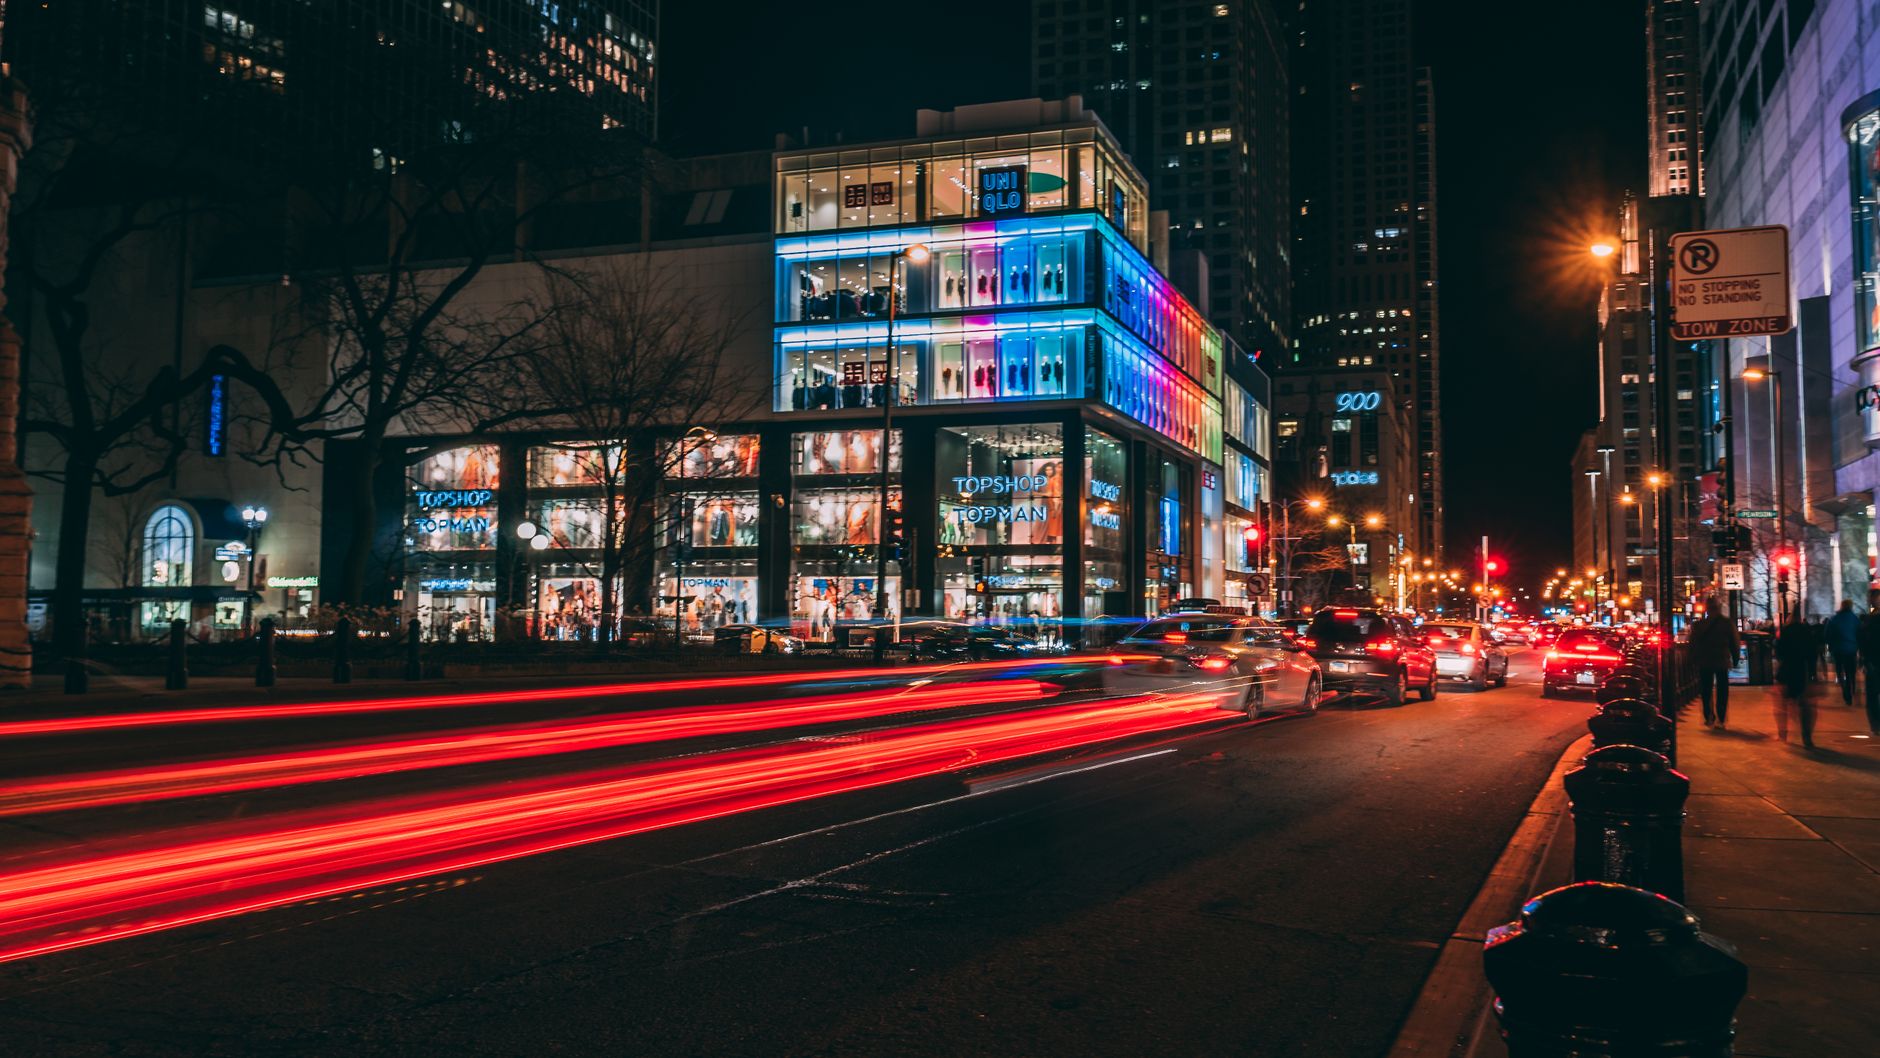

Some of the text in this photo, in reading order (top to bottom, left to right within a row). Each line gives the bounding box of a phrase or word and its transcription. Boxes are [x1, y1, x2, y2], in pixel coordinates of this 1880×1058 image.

[983, 171, 1018, 191] UNI
[983, 191, 1021, 213] QLO
[1679, 279, 1761, 294] NO STOPPING
[1679, 291, 1762, 306] NO STANDING
[1681, 317, 1779, 337] TOW ZONE
[1337, 392, 1381, 413] 900
[952, 474, 1048, 494] TOPSHOP
[415, 489, 493, 507] TOPSHOP
[952, 505, 1048, 524] TOPMAN
[415, 517, 491, 534] TOPMAN
[682, 578, 729, 588] TOPMAN
